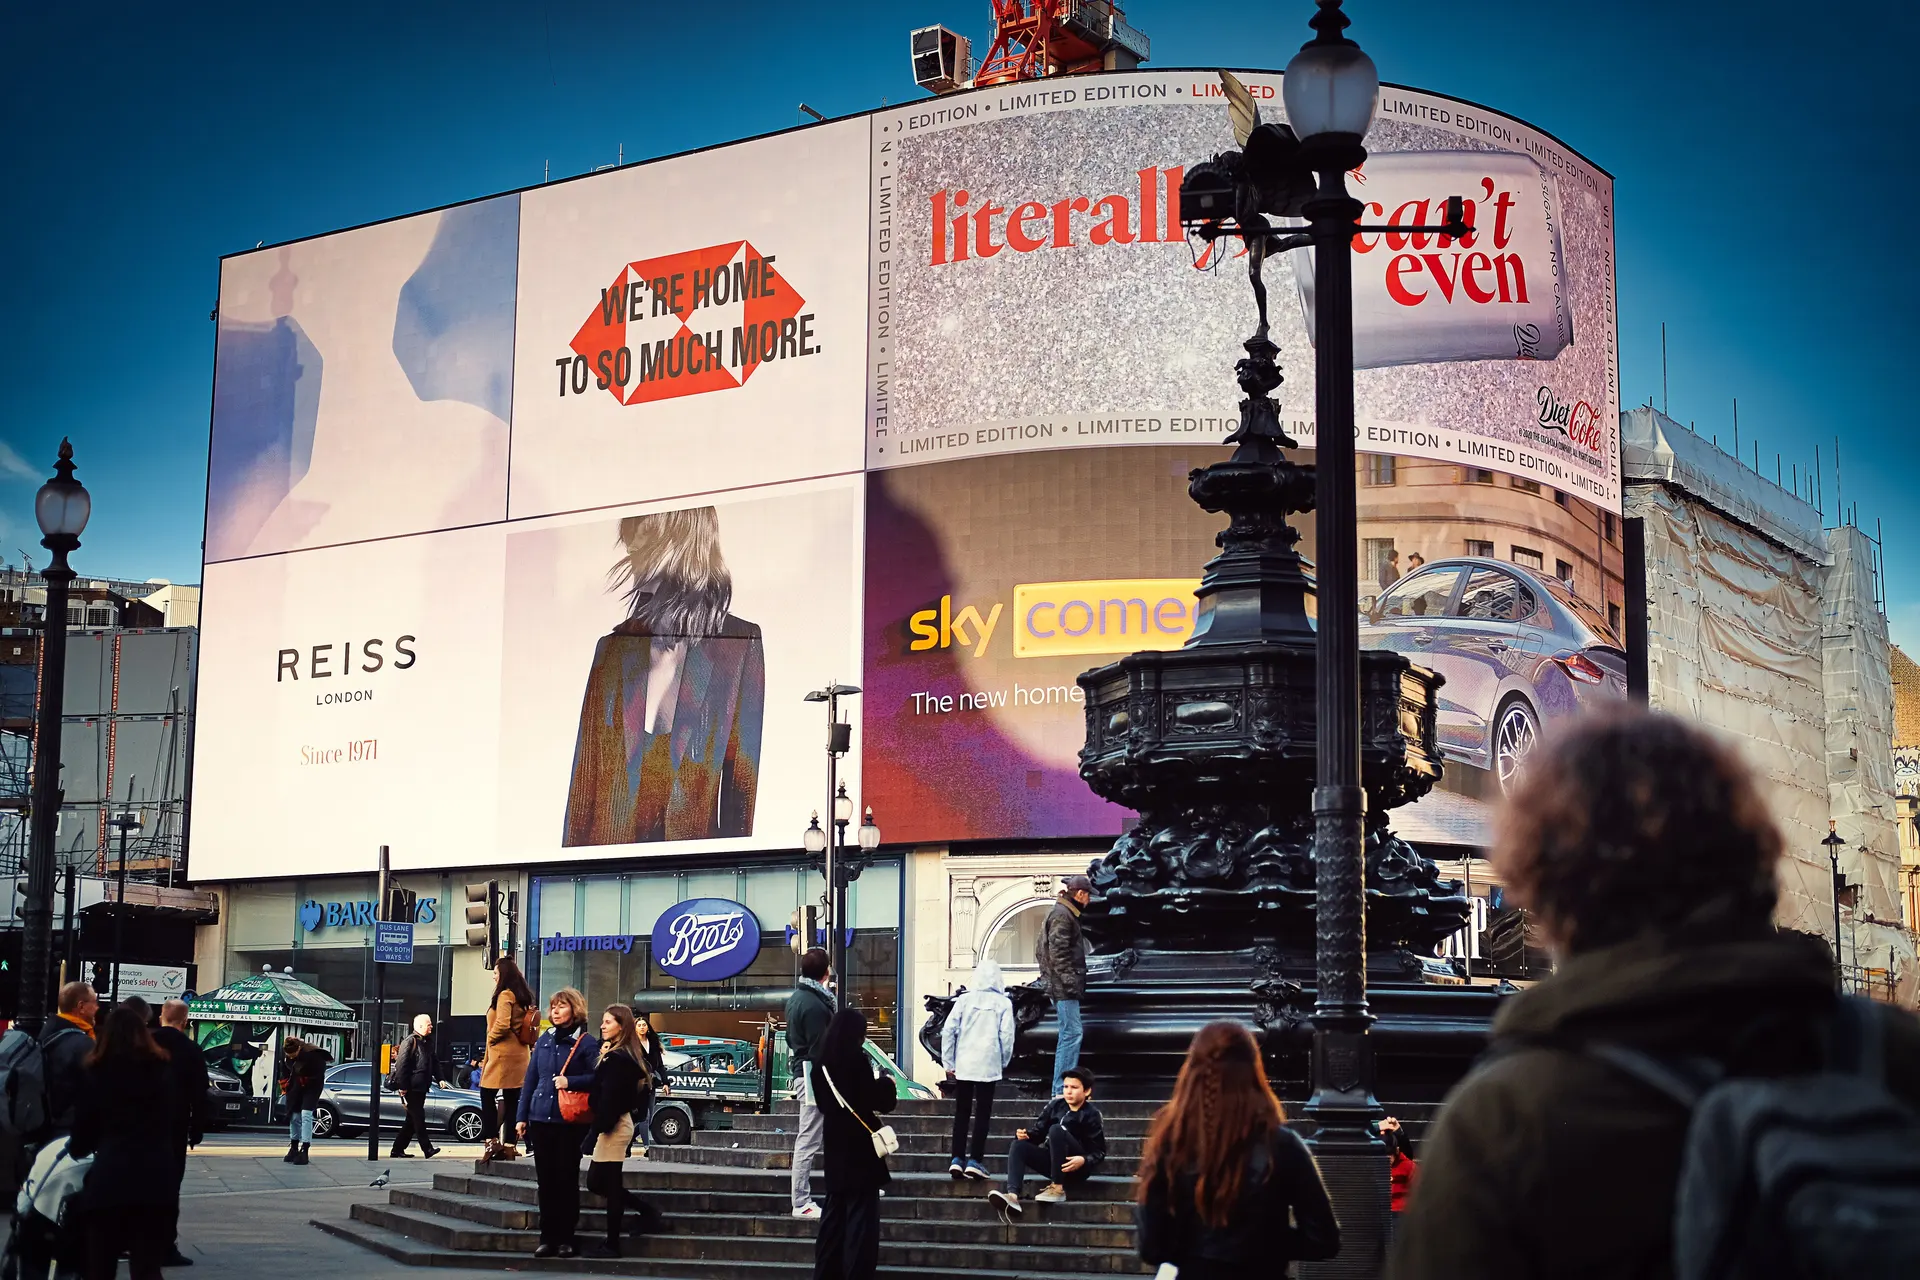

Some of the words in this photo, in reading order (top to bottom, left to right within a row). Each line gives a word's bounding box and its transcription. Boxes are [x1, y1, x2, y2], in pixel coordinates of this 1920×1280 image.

[909, 103, 977, 130] EDITION
[999, 89, 1077, 112] LIMITED
[1084, 84, 1167, 101] EDITION
[1192, 83, 1275, 99] LIMED
[1382, 98, 1451, 124] LIMITED
[1456, 114, 1512, 144] EDITION
[1524, 137, 1564, 169] LIMITED
[1566, 164, 1598, 192] EDITION
[879, 175, 891, 253] LIMITED
[1351, 177, 1516, 254] can't
[1541, 181, 1554, 233] SUGAR
[1549, 251, 1559, 277] NO
[601, 272, 685, 327] WE'RE
[693, 255, 776, 310] HOME
[878, 260, 891, 339] EDITION
[1385, 251, 1530, 306] even
[555, 354, 589, 397] TO
[596, 346, 632, 391] SO
[640, 330, 723, 384] MUCH
[732, 313, 821, 368] MORE.
[1537, 386, 1571, 430] Diet
[1569, 400, 1601, 451] Coke
[899, 432, 970, 455] LIMITED
[976, 423, 1053, 444] EDITION
[1077, 418, 1162, 435] LIMITED
[1170, 417, 1240, 432] EDITIO
[1368, 426, 1439, 449] EDITION
[1458, 438, 1516, 463] LIMITED
[1519, 452, 1562, 479] EDITION
[1571, 470, 1605, 497] LIMITED
[910, 594, 1004, 658] sky
[1026, 597, 1199, 638] come
[277, 635, 416, 682] REISS
[316, 689, 373, 706] LONDON
[911, 691, 954, 716] The
[958, 688, 1008, 711] new
[1014, 683, 1086, 707] home
[300, 744, 343, 766] Since
[347, 739, 378, 762] 1971
[326, 898, 437, 927] BARCYS
[543, 931, 636, 955] pharmacy
[660, 912, 744, 967] Boots
[138, 979, 158, 988] safety
